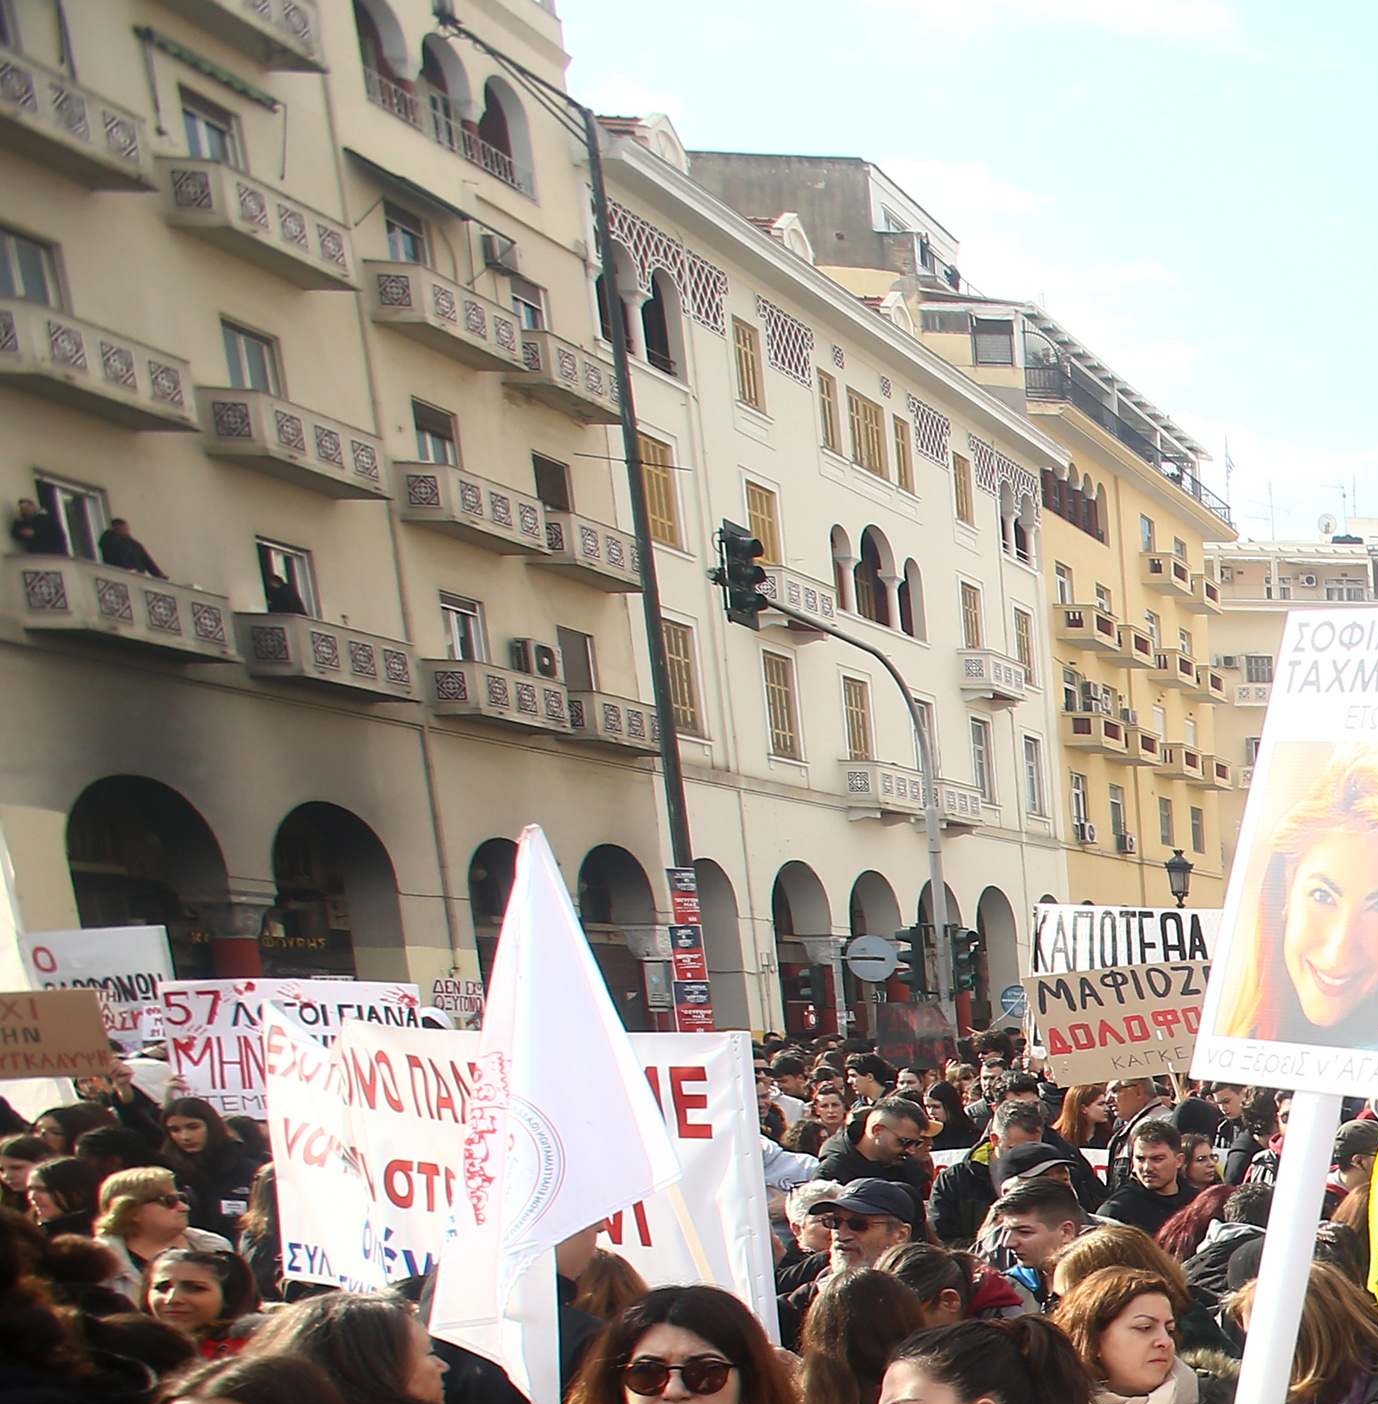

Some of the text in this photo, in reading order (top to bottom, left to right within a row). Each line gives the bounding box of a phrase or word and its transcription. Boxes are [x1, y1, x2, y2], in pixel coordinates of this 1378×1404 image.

[433, 980, 461, 994] ΔΕΝ
[1038, 964, 1211, 1015] ΜΑΦΙΟΖ
[164, 990, 222, 1027] 57
[1207, 1046, 1234, 1069] να
